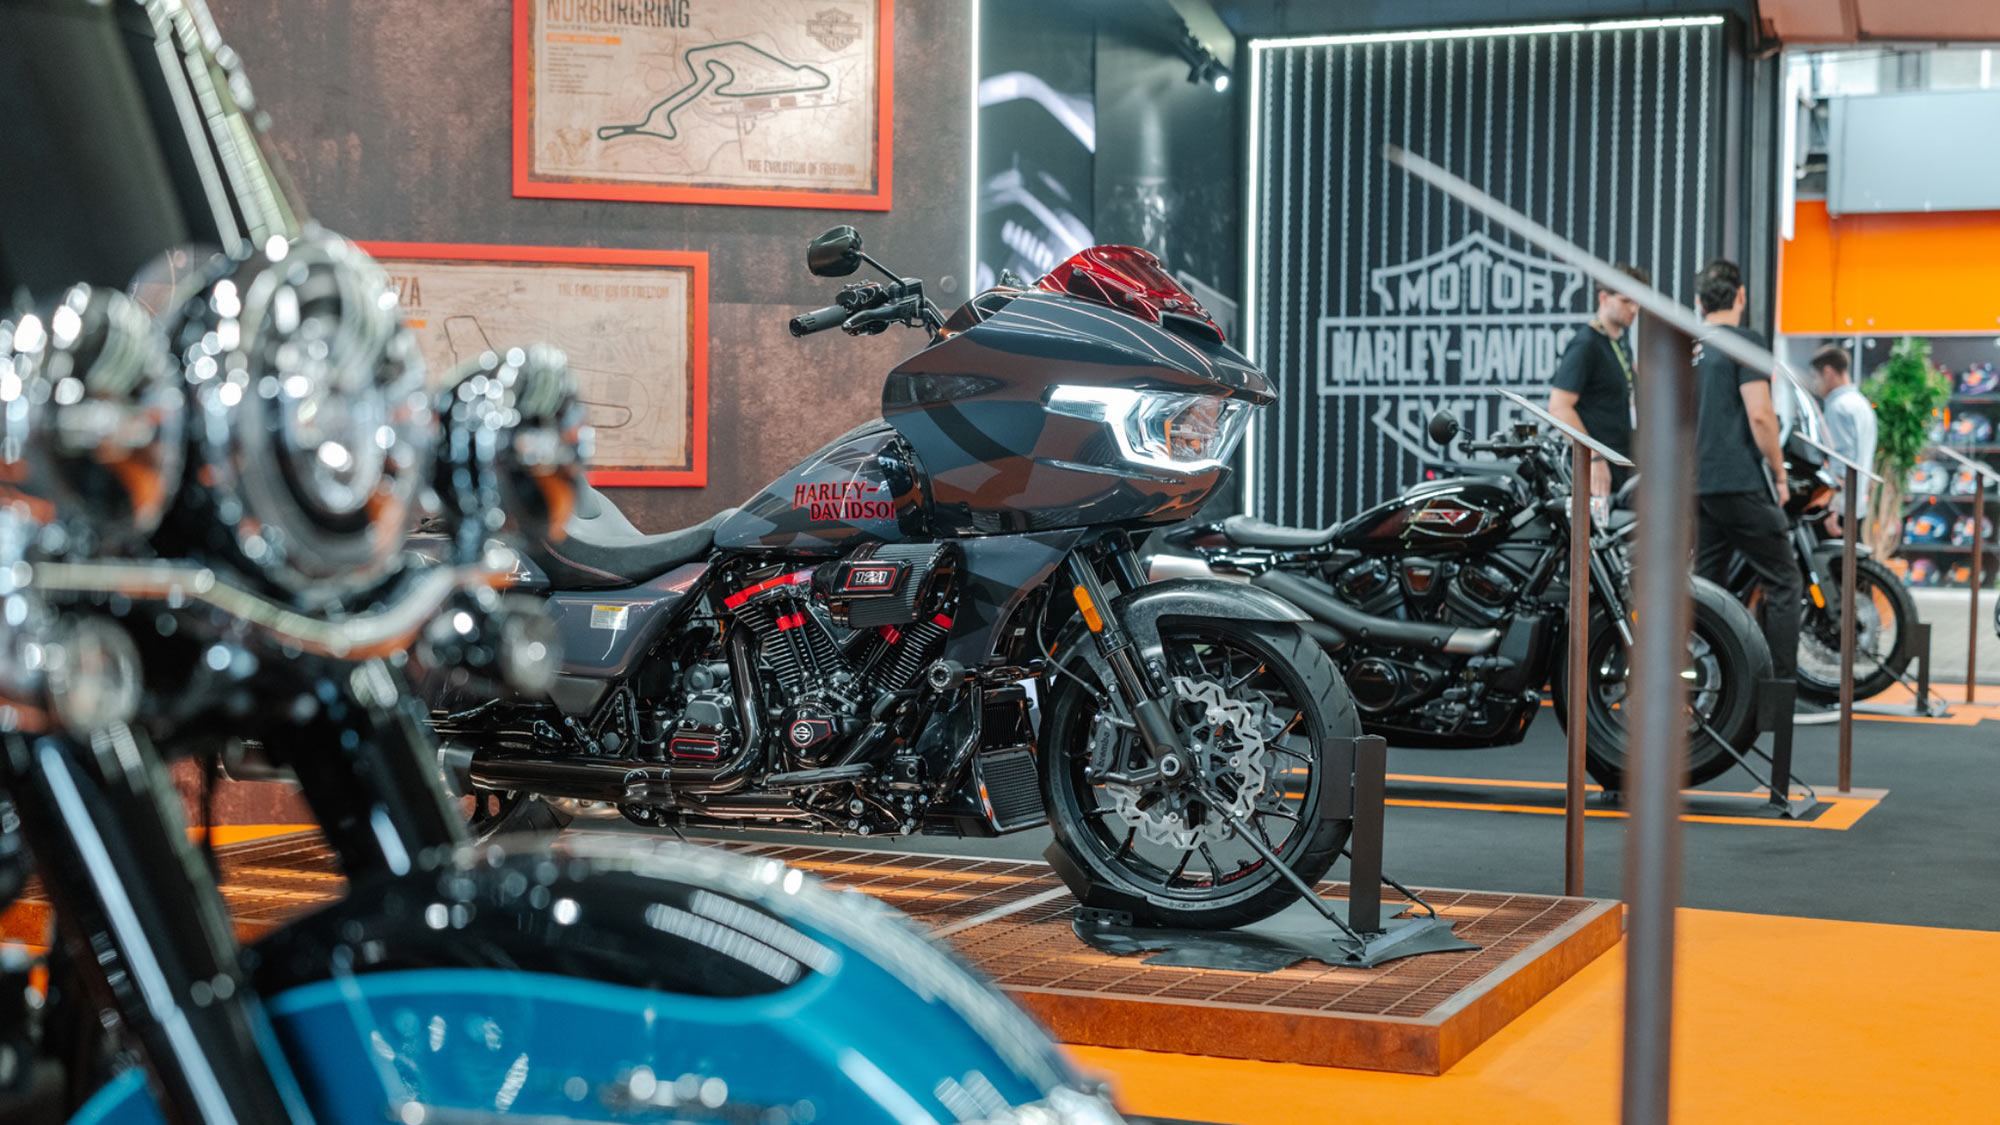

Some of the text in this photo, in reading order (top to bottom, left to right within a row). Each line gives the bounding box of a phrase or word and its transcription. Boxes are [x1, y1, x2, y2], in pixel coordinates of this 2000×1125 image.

[1400, 248, 1554, 310] MOTOR
[792, 481, 879, 510] HARLEY-
[855, 571, 888, 583] 121
[1096, 731, 1110, 767] brembo
